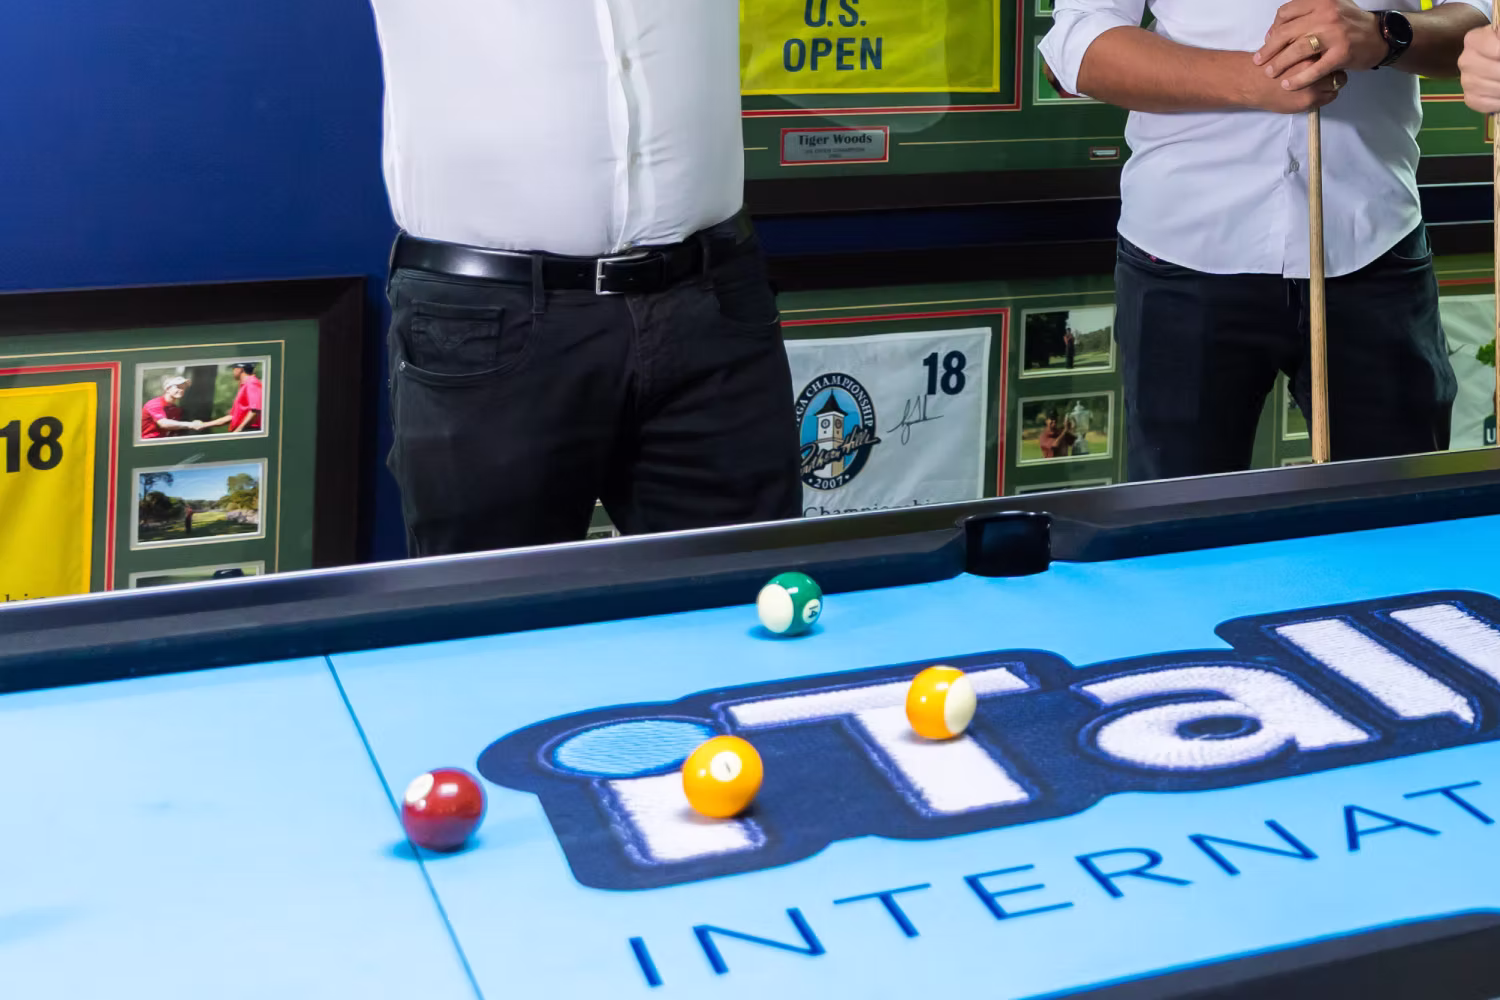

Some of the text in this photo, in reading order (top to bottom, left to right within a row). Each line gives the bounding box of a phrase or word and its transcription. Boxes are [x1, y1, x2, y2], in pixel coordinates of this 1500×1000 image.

[782, 37, 882, 73] OPEN
[799, 133, 873, 146] Tiger Woods
[923, 350, 967, 396] 18
[805, 375, 874, 427] CHAMPIONSHIP
[0, 416, 64, 473] 18
[813, 476, 844, 489] 2007
[808, 605, 819, 618] 14
